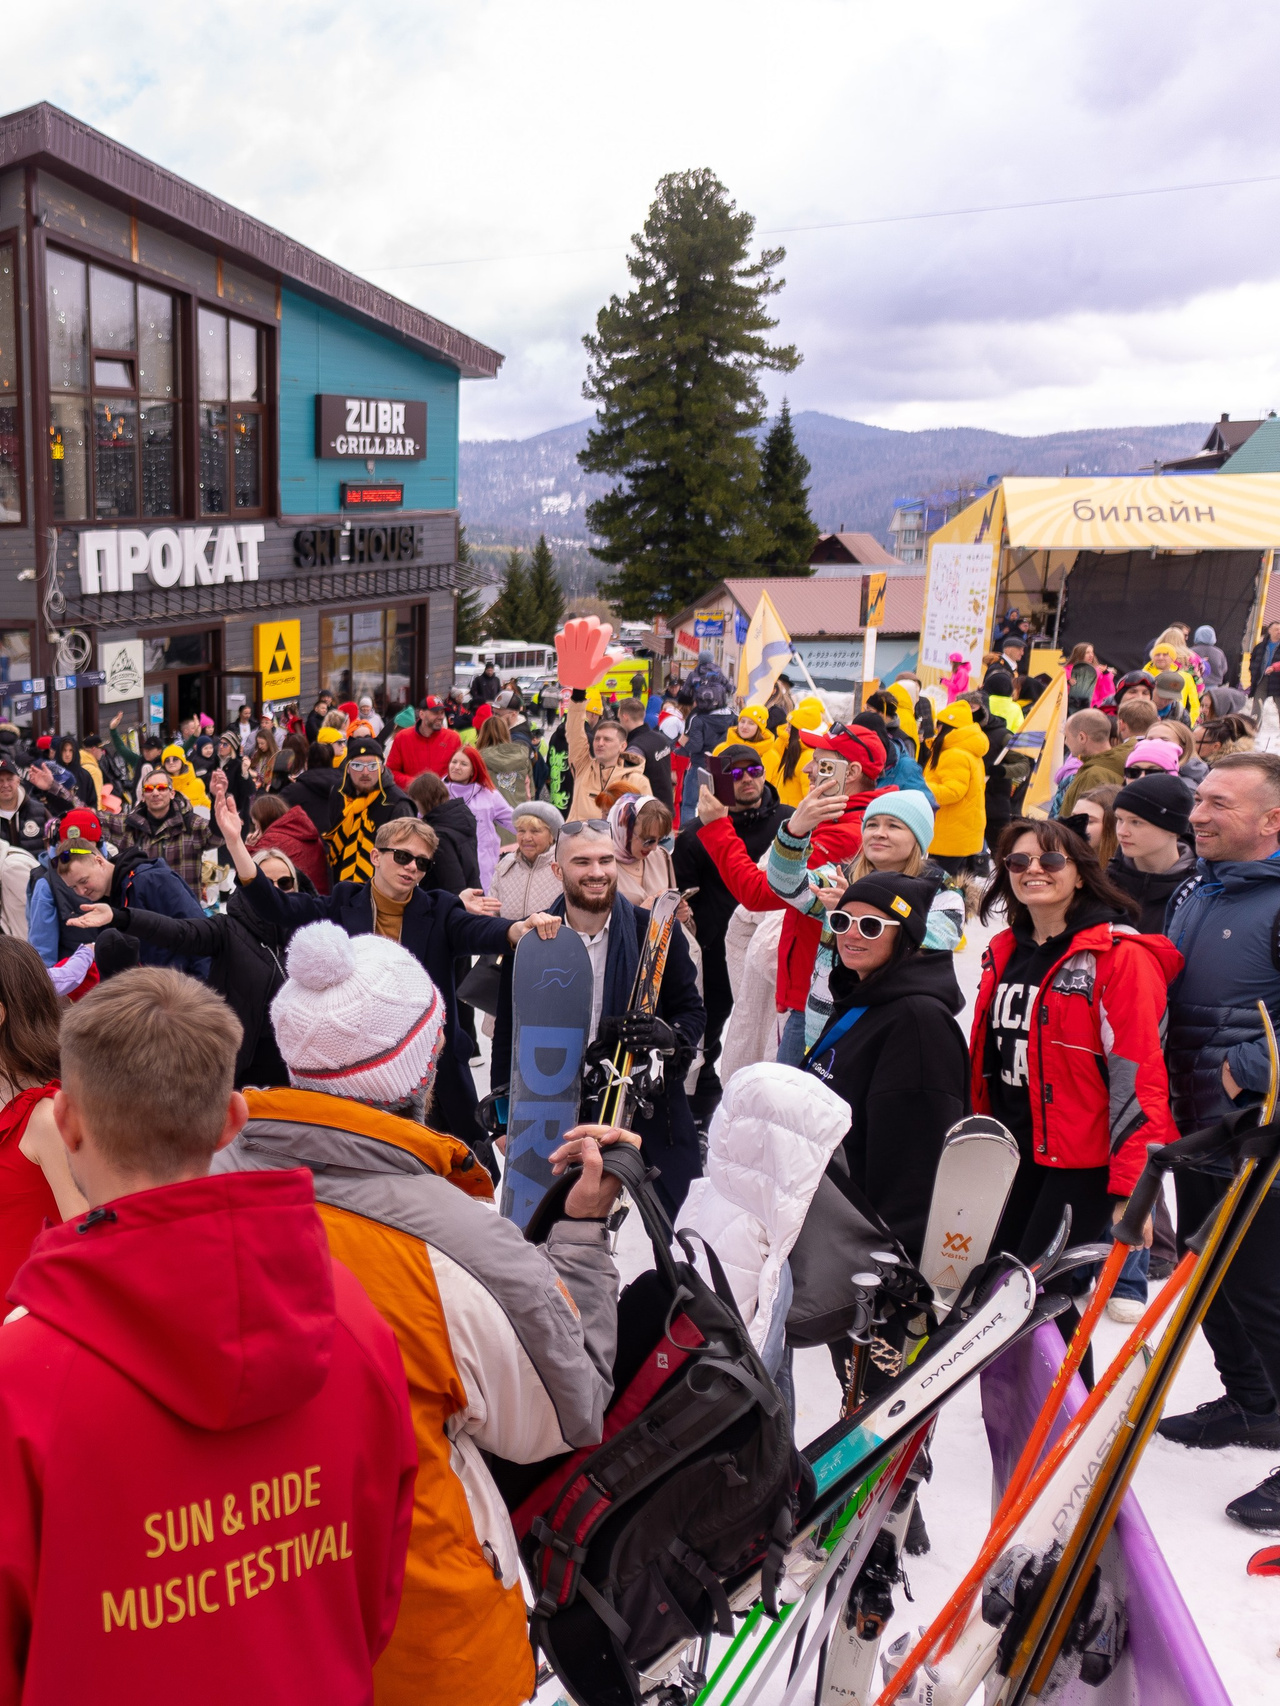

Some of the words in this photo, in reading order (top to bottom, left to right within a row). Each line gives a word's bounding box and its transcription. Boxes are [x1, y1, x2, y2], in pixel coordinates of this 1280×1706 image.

[345, 399, 406, 434] ZUBR
[1073, 499, 1215, 523] билайн
[78, 524, 266, 595] ПРОКАТ
[293, 529, 351, 568] SKI
[350, 526, 424, 564] HOUSE
[265, 676, 296, 687] FISCHER
[920, 1311, 1005, 1390] DYNASTAR
[144, 1498, 215, 1559] SUN
[221, 1493, 246, 1536] &
[250, 1465, 321, 1526] RIDE
[101, 1569, 220, 1633] MUSIC
[225, 1521, 353, 1607] FESTIVAL
[830, 1685, 856, 1697] FLAIR
